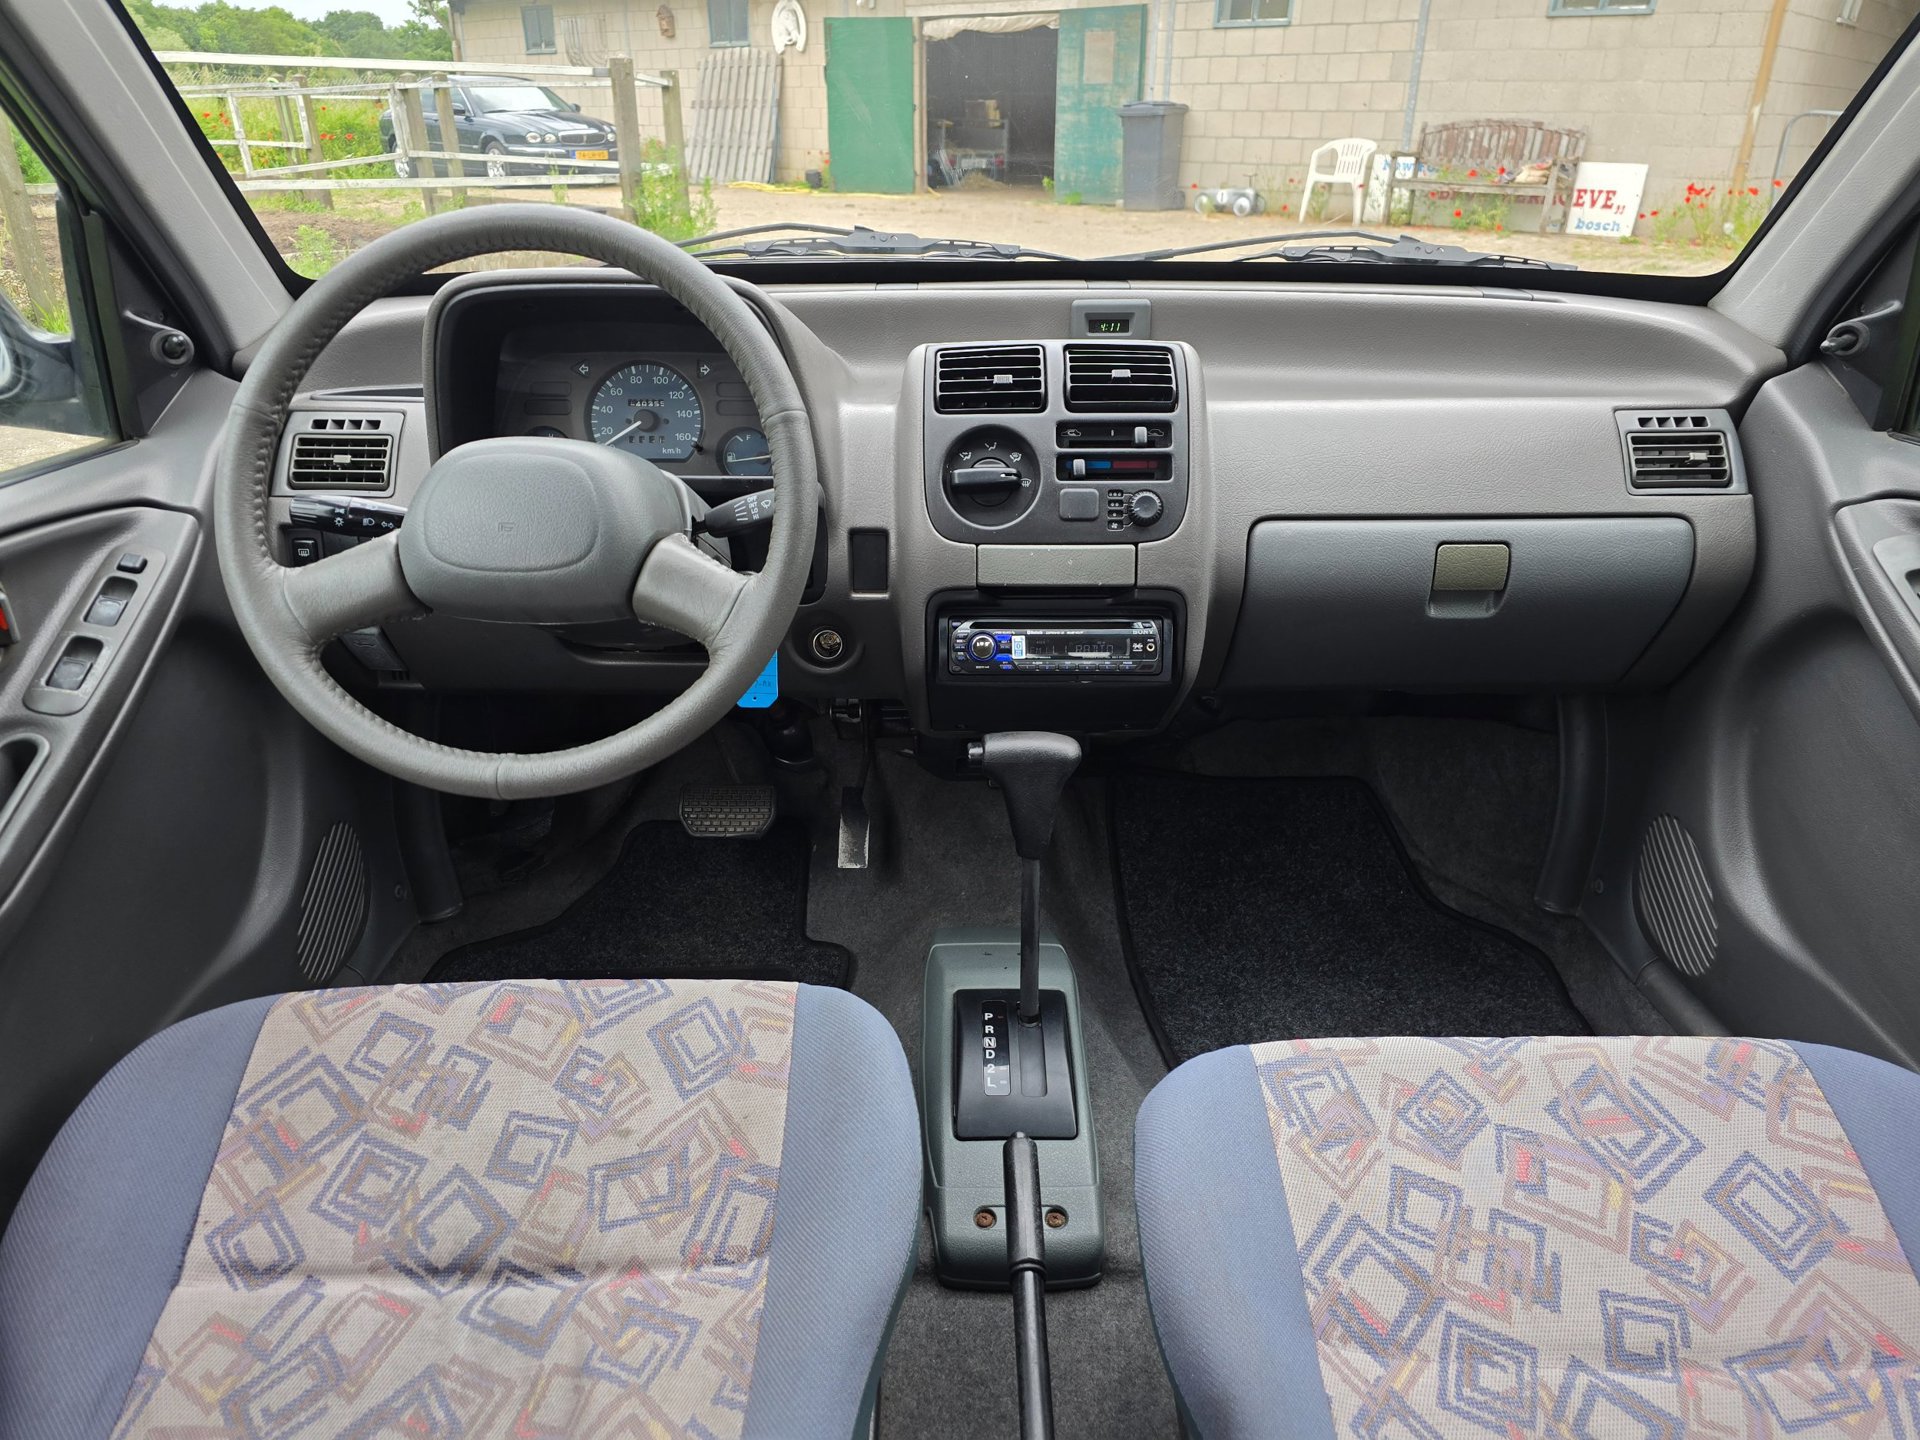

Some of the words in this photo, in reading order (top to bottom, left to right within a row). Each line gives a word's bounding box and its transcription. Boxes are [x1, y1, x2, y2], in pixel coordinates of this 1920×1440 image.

[1575, 218, 1621, 232] bosch
[1100, 322, 1121, 332] 4:11
[630, 376, 643, 385] 80
[652, 376, 669, 385] 100
[610, 387, 623, 396] 60
[668, 390, 685, 400] 120
[600, 405, 613, 414] 40
[676, 409, 693, 418] 140
[601, 426, 613, 435] 20
[675, 432, 691, 441] 160
[662, 446, 681, 455] km/h
[984, 1012, 994, 1021] P
[984, 1025, 994, 1034] R
[985, 1038, 995, 1047] N
[985, 1049, 996, 1059] D
[986, 1063, 996, 1074] 2
[987, 1077, 997, 1088] L
